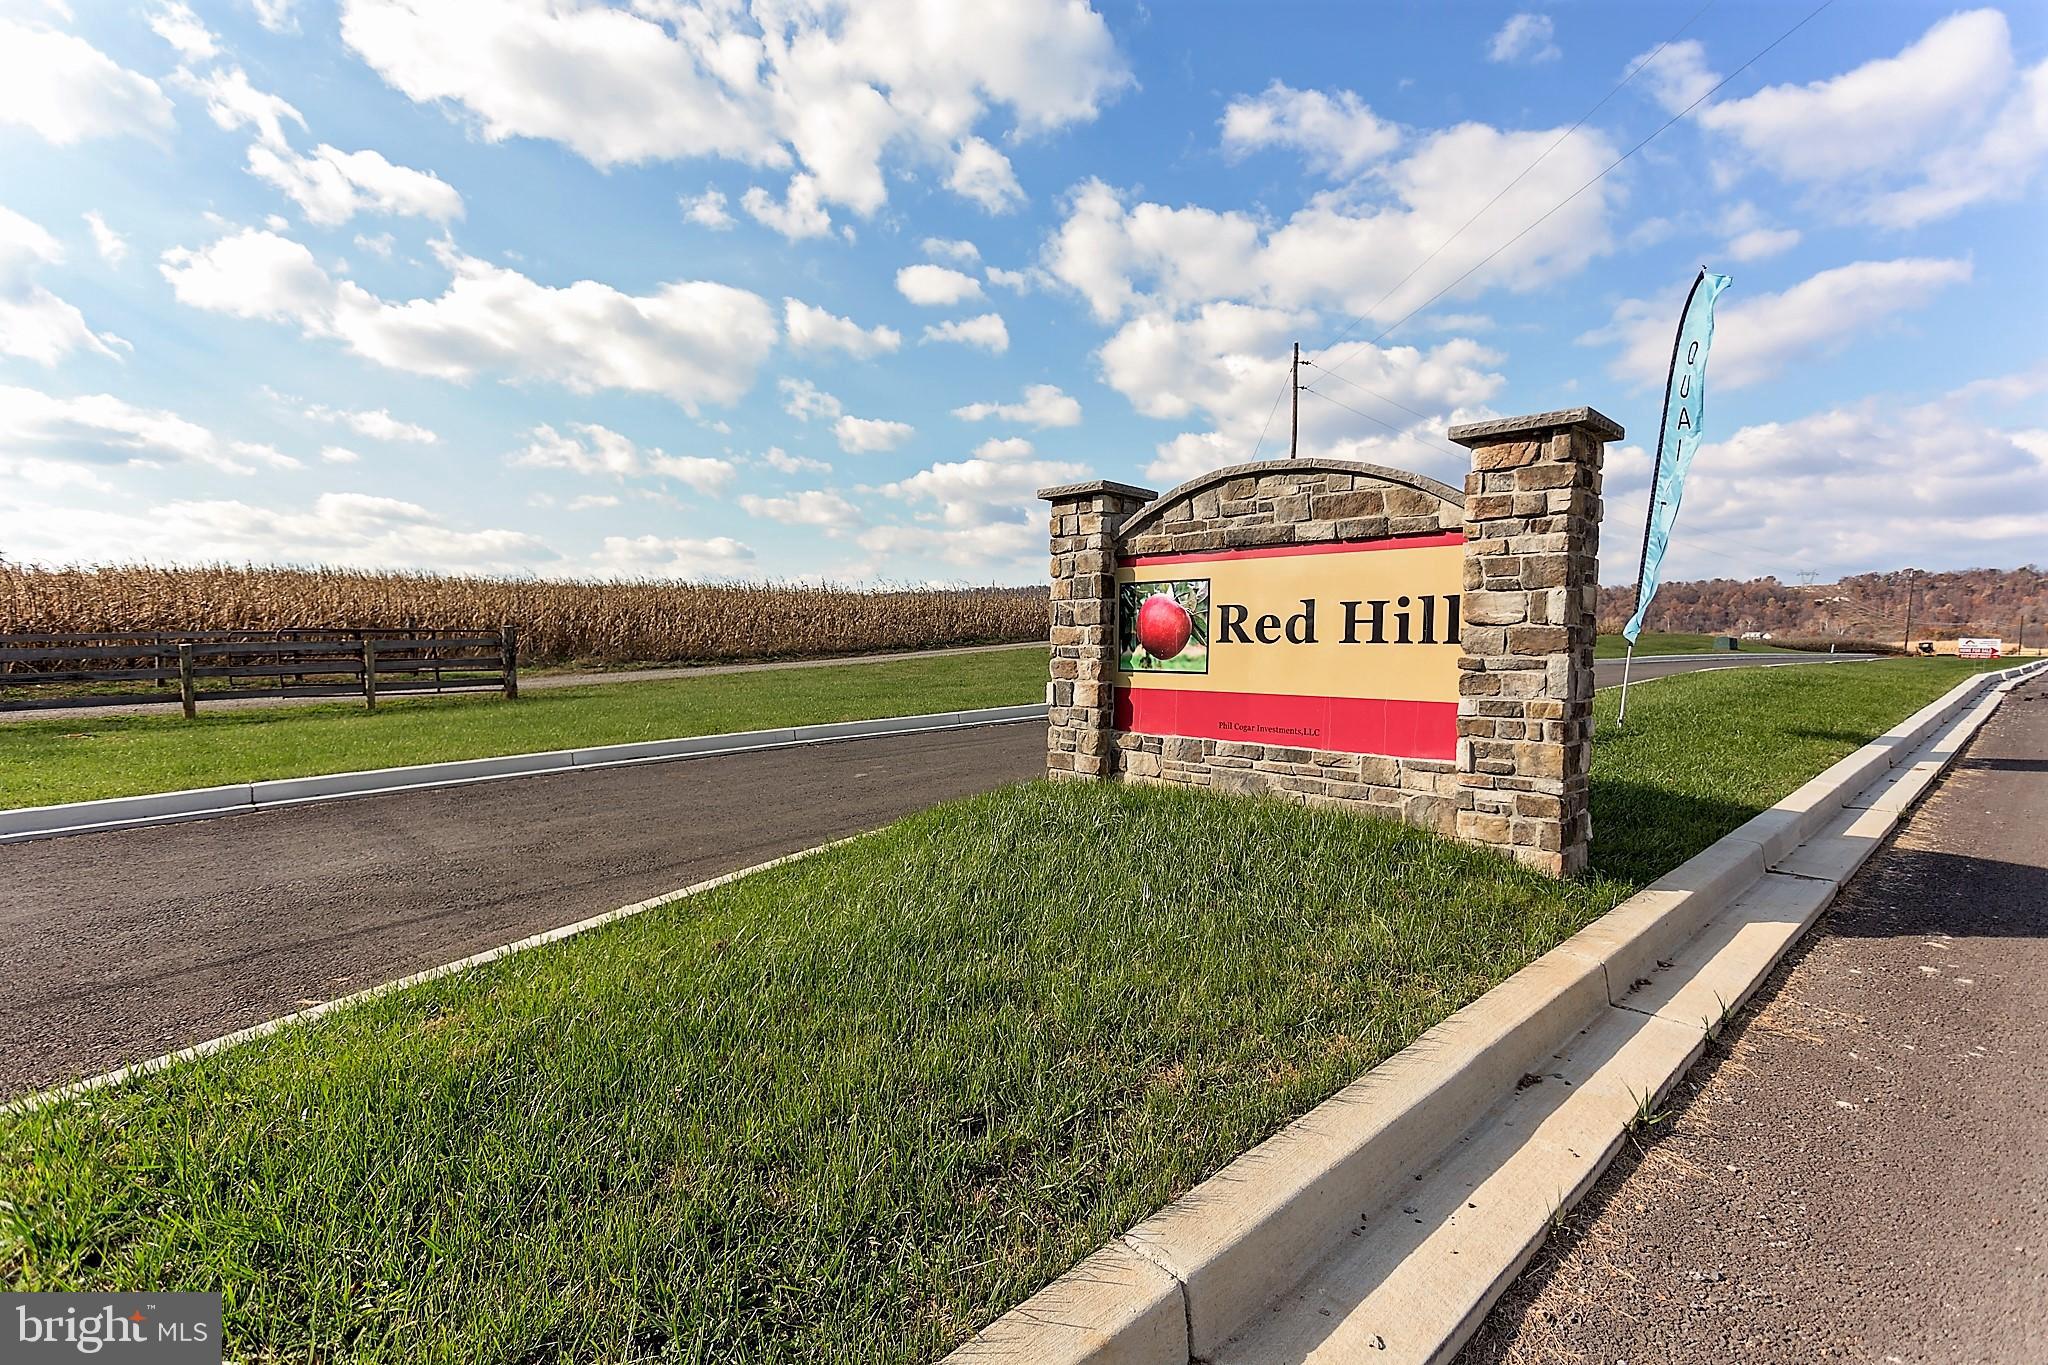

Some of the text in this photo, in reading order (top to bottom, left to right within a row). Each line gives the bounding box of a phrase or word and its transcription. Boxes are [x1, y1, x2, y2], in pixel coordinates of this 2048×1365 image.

[1215, 594, 1462, 645] Red Hill
[1218, 721, 1233, 730] Phil
[1234, 722, 1255, 733] Cogar
